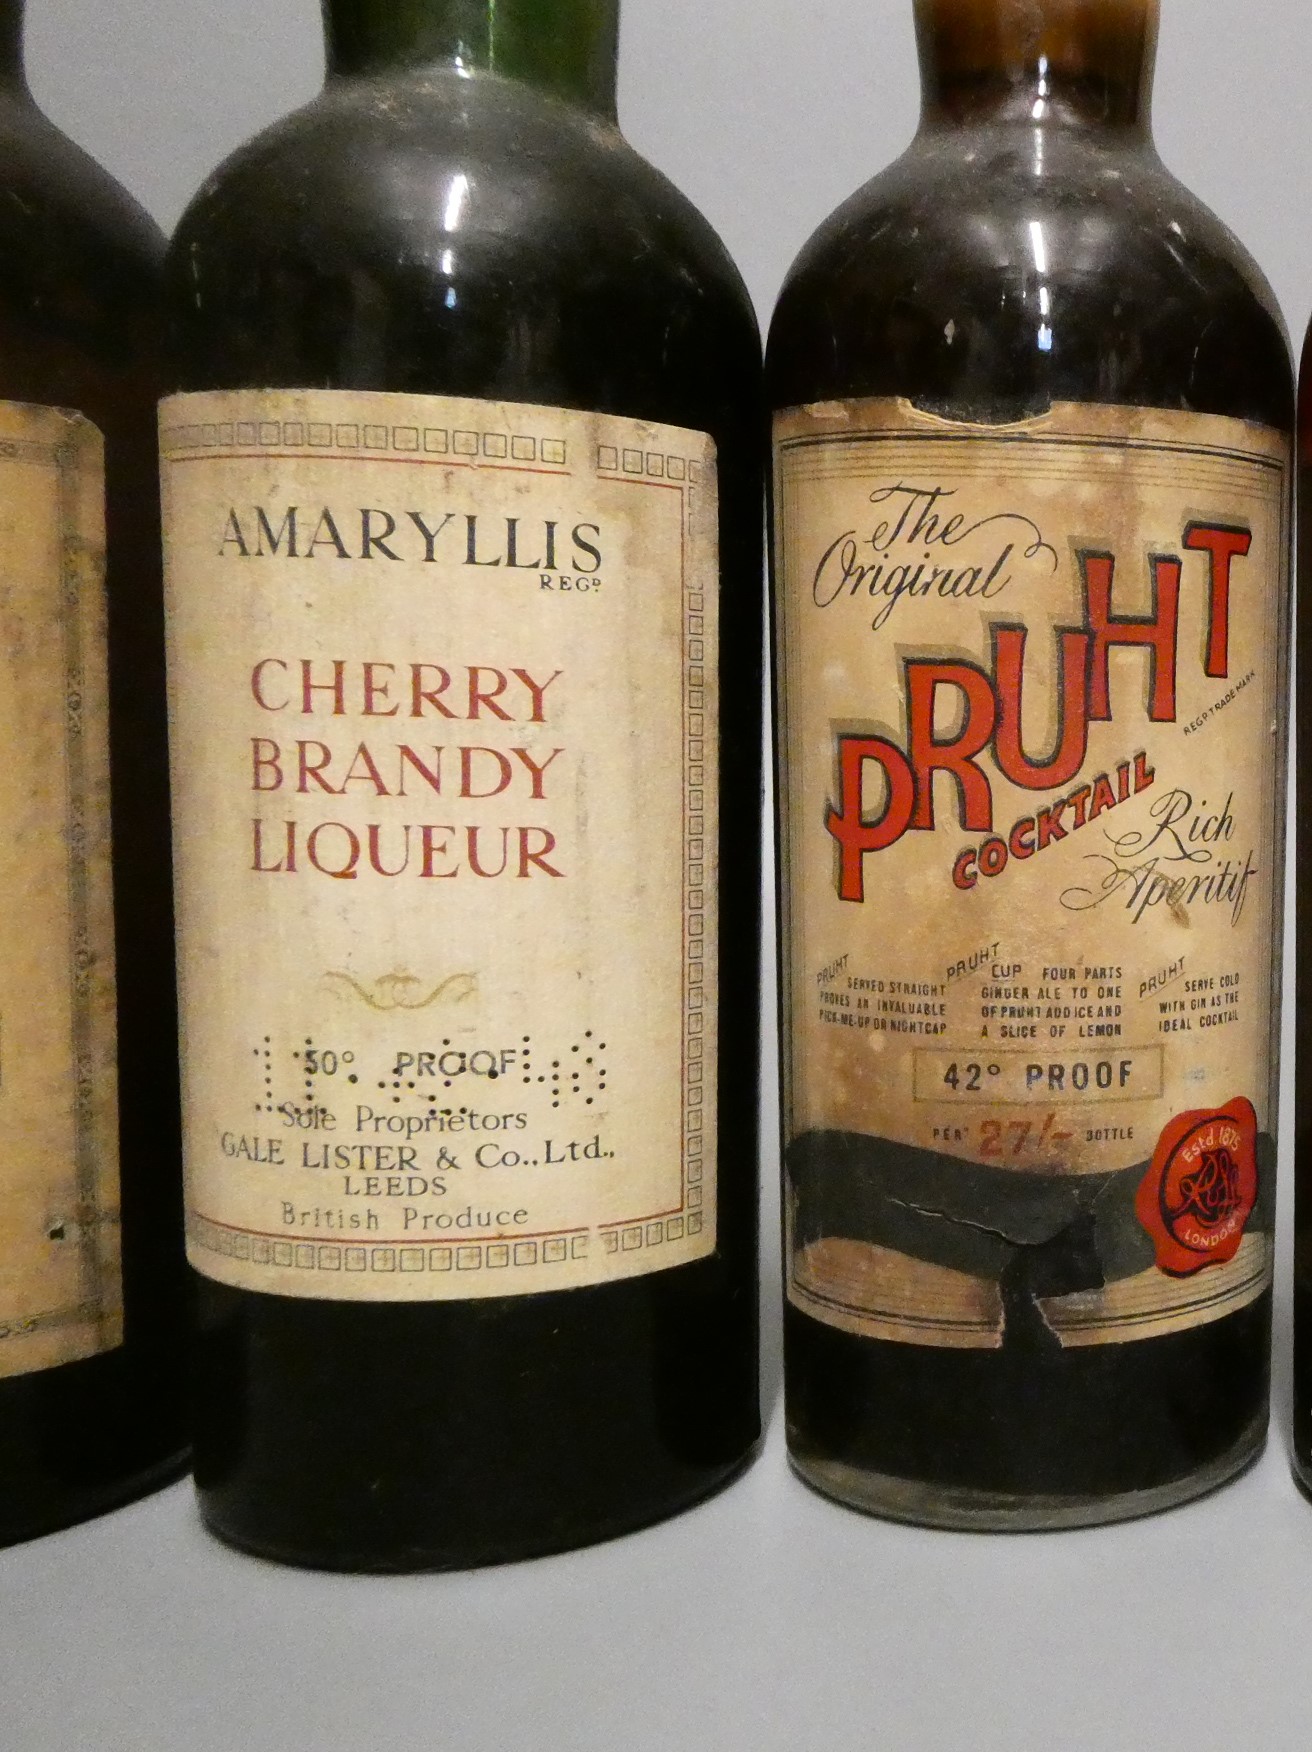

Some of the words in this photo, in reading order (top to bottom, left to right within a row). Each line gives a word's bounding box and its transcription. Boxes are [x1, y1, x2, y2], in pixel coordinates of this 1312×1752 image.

[863, 481, 1042, 556] The
[218, 505, 603, 574] AMARYLLIS
[813, 531, 1015, 631] Original
[250, 658, 565, 723] CHERRY
[824, 516, 1252, 904] PRUHT
[1209, 689, 1236, 716] TRADE
[1235, 669, 1256, 692] MARK
[250, 737, 566, 800] BRANDY
[952, 751, 1156, 891] COCKTAIL
[1103, 787, 1237, 863] Rich
[250, 818, 567, 880] LIQUEUR
[1059, 850, 1258, 928] Aperitif
[816, 953, 849, 985] PRUHT
[946, 941, 1000, 982] PRUHT
[991, 963, 1022, 979] CUP
[1042, 967, 1076, 981] FOUR
[1084, 966, 1123, 980] PARTS
[1139, 956, 1185, 999] PRUHT
[1184, 977, 1214, 992] SERVE
[1220, 971, 1240, 988] COLD
[820, 990, 850, 1007] PROVES
[857, 997, 869, 1010] AN
[877, 998, 946, 1016] INVALUABLE
[847, 977, 884, 993] SERVED
[889, 981, 947, 997] STRAIGHT
[981, 986, 1029, 1000] GINGER
[1037, 987, 1061, 1000] ALE
[1072, 987, 1088, 1000] TO
[1097, 985, 1122, 999] ONE
[1159, 1000, 1186, 1014] WITH
[1191, 997, 1206, 1011] GIN
[1211, 994, 1221, 1007] AS
[1225, 990, 1239, 1004] THE
[819, 1009, 870, 1028] PICK-ME-UP
[873, 1017, 887, 1031] OR
[890, 1019, 947, 1035] NIGHTCAP
[981, 1005, 998, 1019] OF
[1000, 1005, 1041, 1019] PRUHT
[1046, 1005, 1071, 1019] ADD
[1074, 1005, 1093, 1019] ICE
[1097, 1004, 1122, 1018] AND
[981, 1024, 988, 1038] A
[1000, 1024, 1037, 1038] SLICE
[1050, 1025, 1066, 1038] OF
[1079, 1023, 1122, 1037] LEMON
[1159, 1018, 1192, 1033] IDEAL
[1200, 1009, 1239, 1028] COCKTAIL
[395, 1049, 517, 1078] PROOF
[944, 1062, 1001, 1091] 42°
[1026, 1060, 1133, 1091] PROOF
[281, 1101, 337, 1131] Sole
[356, 1104, 528, 1140] Proprietors
[1085, 1126, 1134, 1142] BOTTLE
[221, 1131, 285, 1165] GALE
[302, 1143, 421, 1172] LISTER
[436, 1145, 460, 1171] &
[344, 1176, 448, 1197] LEEDS
[282, 1201, 379, 1231] British
[403, 1206, 529, 1231] Produce
